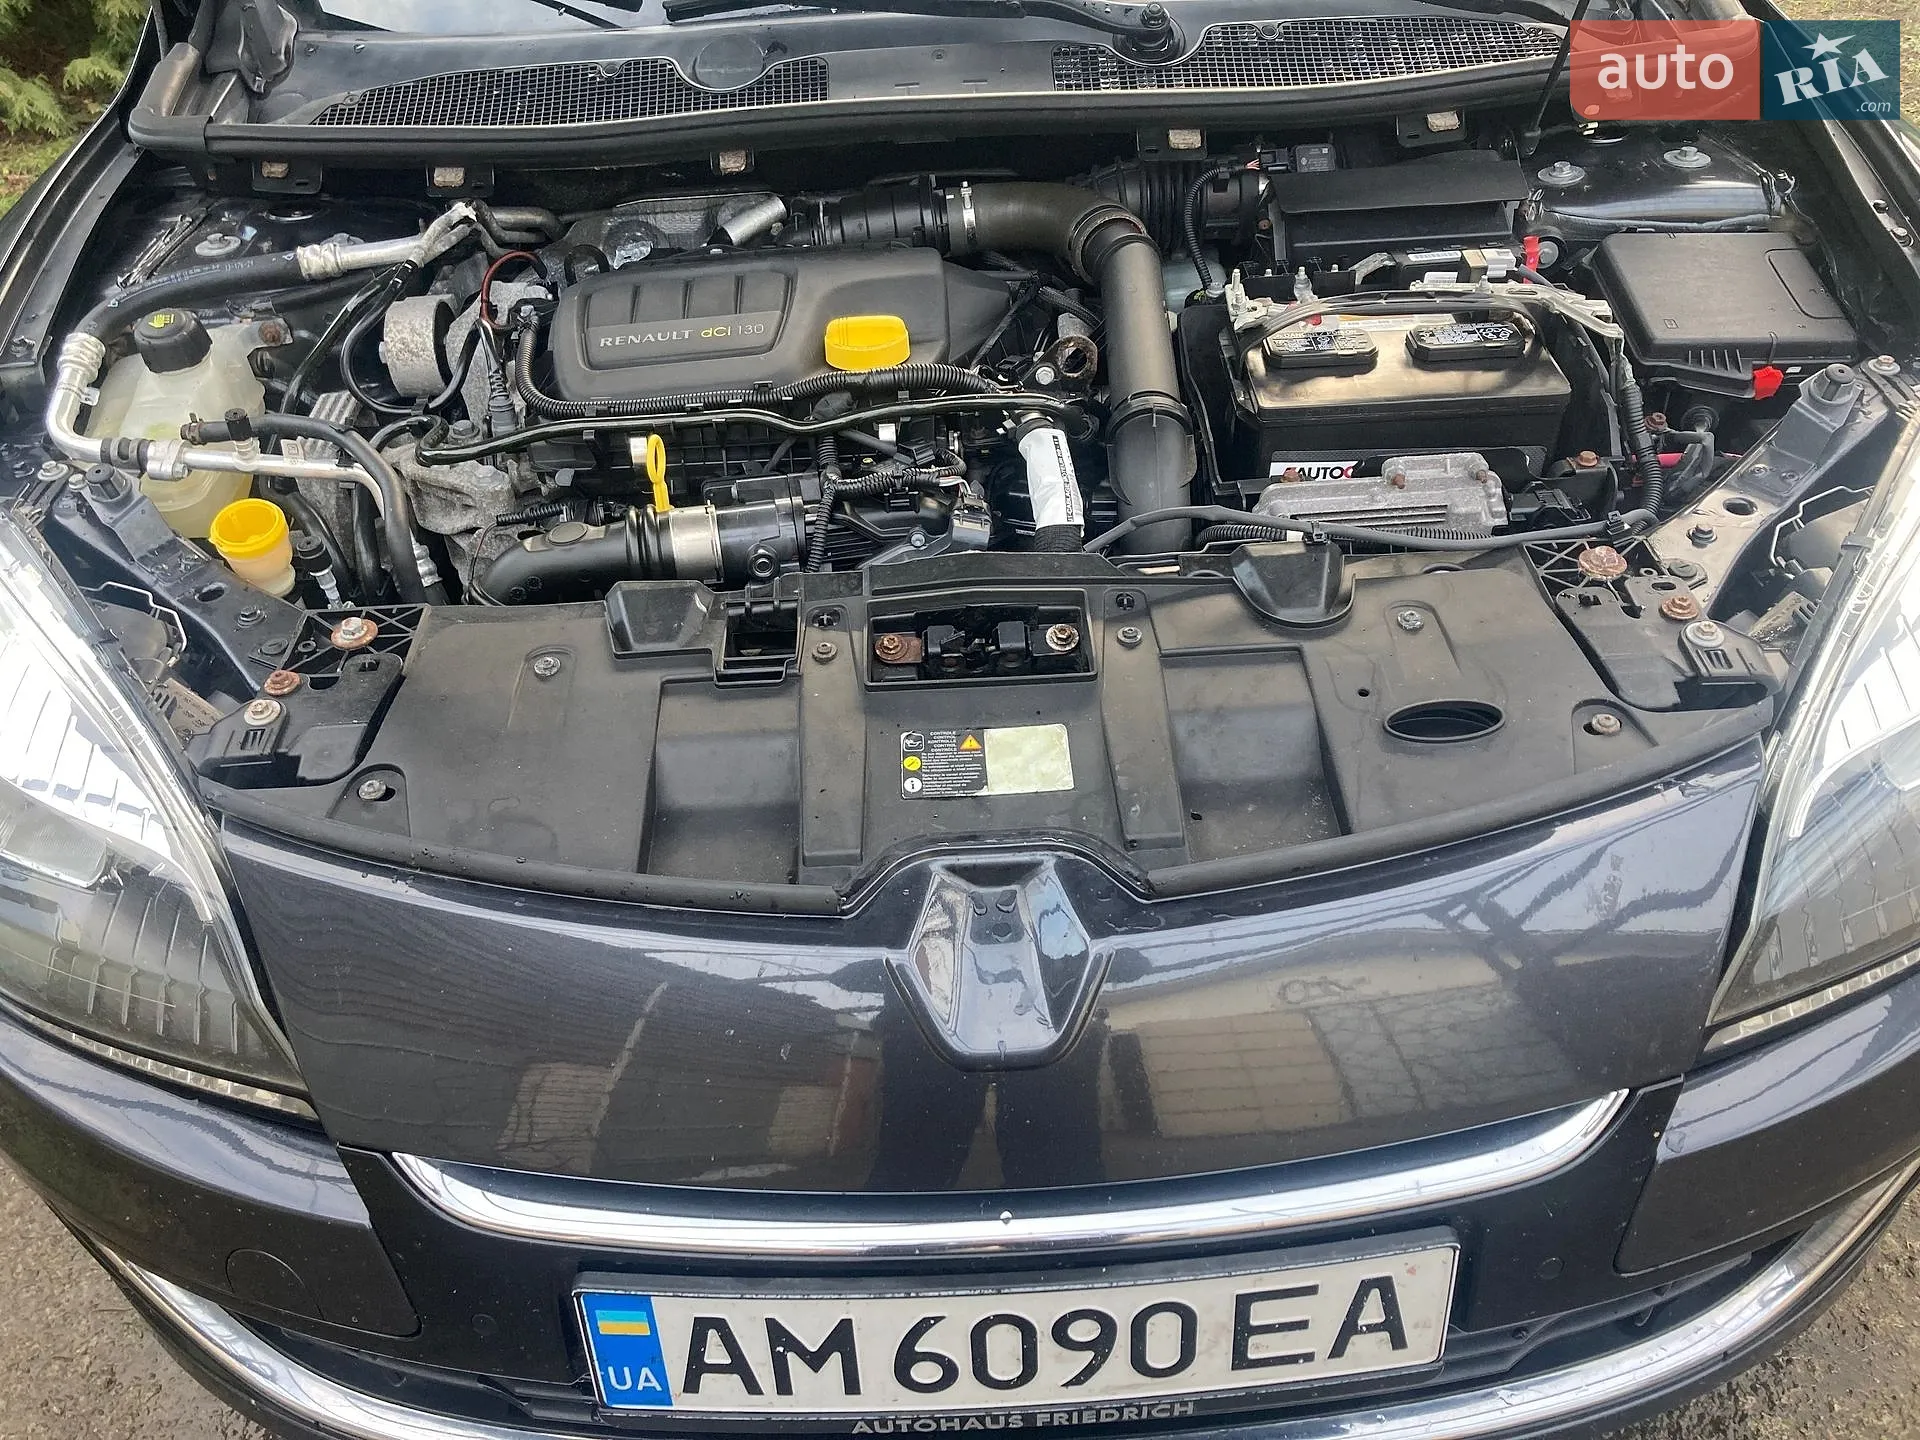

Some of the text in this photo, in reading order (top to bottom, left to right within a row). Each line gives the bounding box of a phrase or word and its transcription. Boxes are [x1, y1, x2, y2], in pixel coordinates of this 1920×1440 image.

[600, 329, 694, 347] RENAULT
[738, 323, 764, 335] 130
[682, 1275, 1408, 1396] AM 6090 EA
[607, 1365, 662, 1391] UA
[851, 1401, 1194, 1435] AUTOHAUS FRIEDRICH
